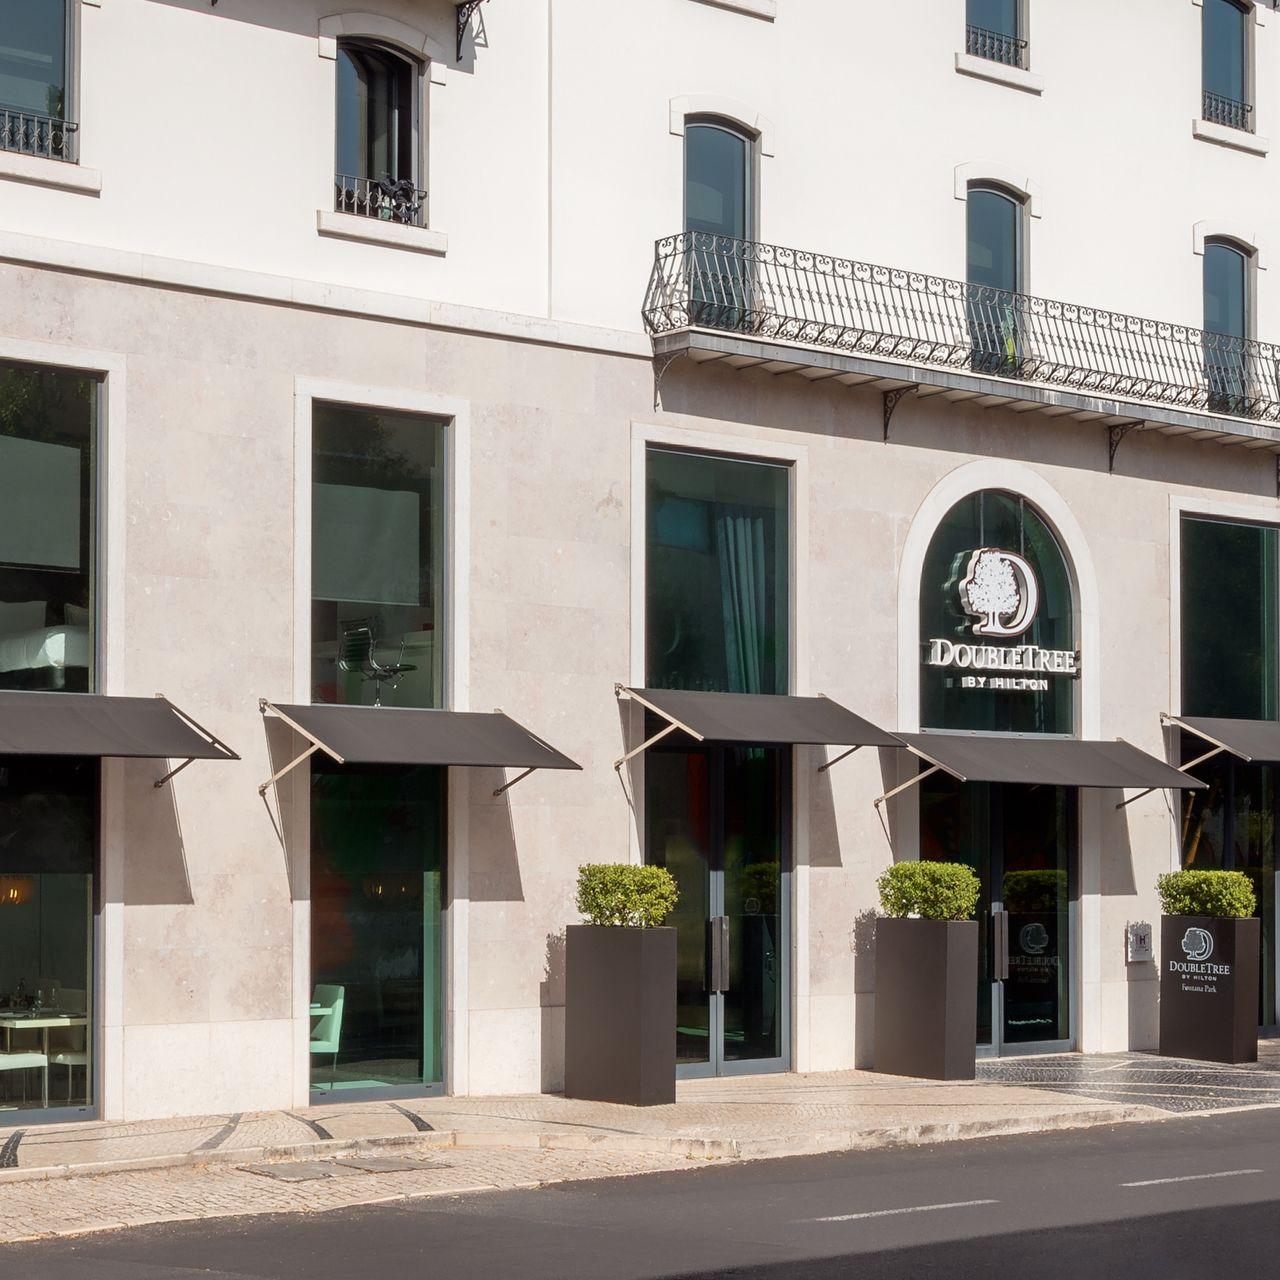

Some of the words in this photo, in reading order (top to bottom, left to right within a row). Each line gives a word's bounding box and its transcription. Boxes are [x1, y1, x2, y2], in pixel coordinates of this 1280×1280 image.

[964, 676, 987, 688] BY
[992, 677, 1048, 690] HILTON
[1181, 983, 1204, 992] Fontana
[1204, 984, 1217, 993] Park
